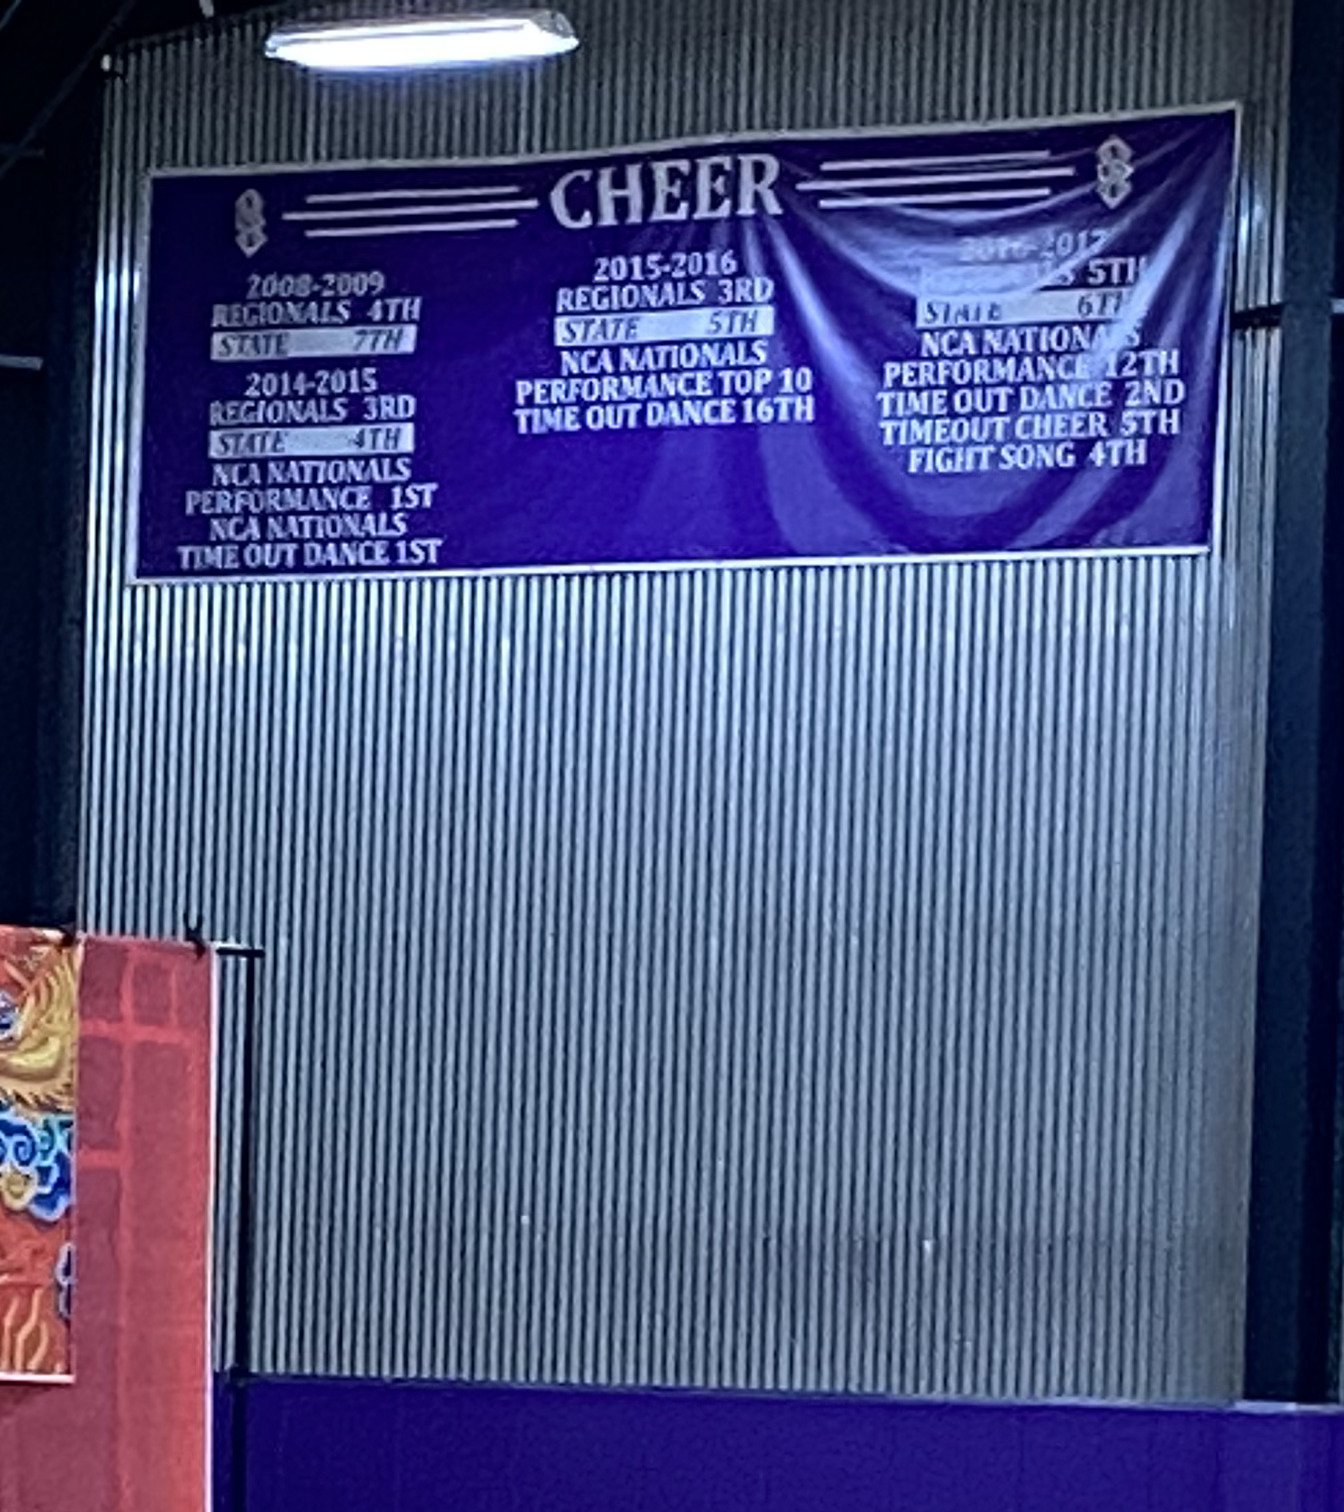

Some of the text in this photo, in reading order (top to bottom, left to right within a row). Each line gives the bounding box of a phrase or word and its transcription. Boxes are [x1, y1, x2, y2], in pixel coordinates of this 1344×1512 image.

[550, 153, 783, 229] CHEER
[594, 250, 737, 281] 2015-2016
[556, 277, 774, 313] REGIONALS 3RD
[211, 297, 422, 328] REGIONALS 4TH
[562, 310, 758, 343] STATE 5TH
[219, 330, 403, 357] STATE 7TH
[921, 324, 1140, 357] NCA NATIONAS
[560, 340, 768, 376] NCA NATIONALS
[883, 349, 1179, 387] PERFORMANCE 12TH
[244, 367, 377, 398] 2014-2015
[516, 367, 812, 405] PERFORMANCE TOP 10
[876, 379, 1184, 417] TIME OUT DANCE 2ND
[210, 395, 415, 426] REGIONALS 3RD
[513, 395, 815, 434] TIME OUT DANCE 16TH
[879, 409, 1181, 445] TIMEOUT CHEER 5TH
[219, 427, 401, 455] STATE 4TH
[908, 439, 1146, 474] FIGHT SONG 4TH
[212, 458, 412, 486] NCA NATIONALS
[185, 483, 438, 516] PERFORMANCE 1ST
[210, 512, 407, 541] NCA NATIONALS
[177, 538, 444, 570] TIME OUT DANCE 1ST
